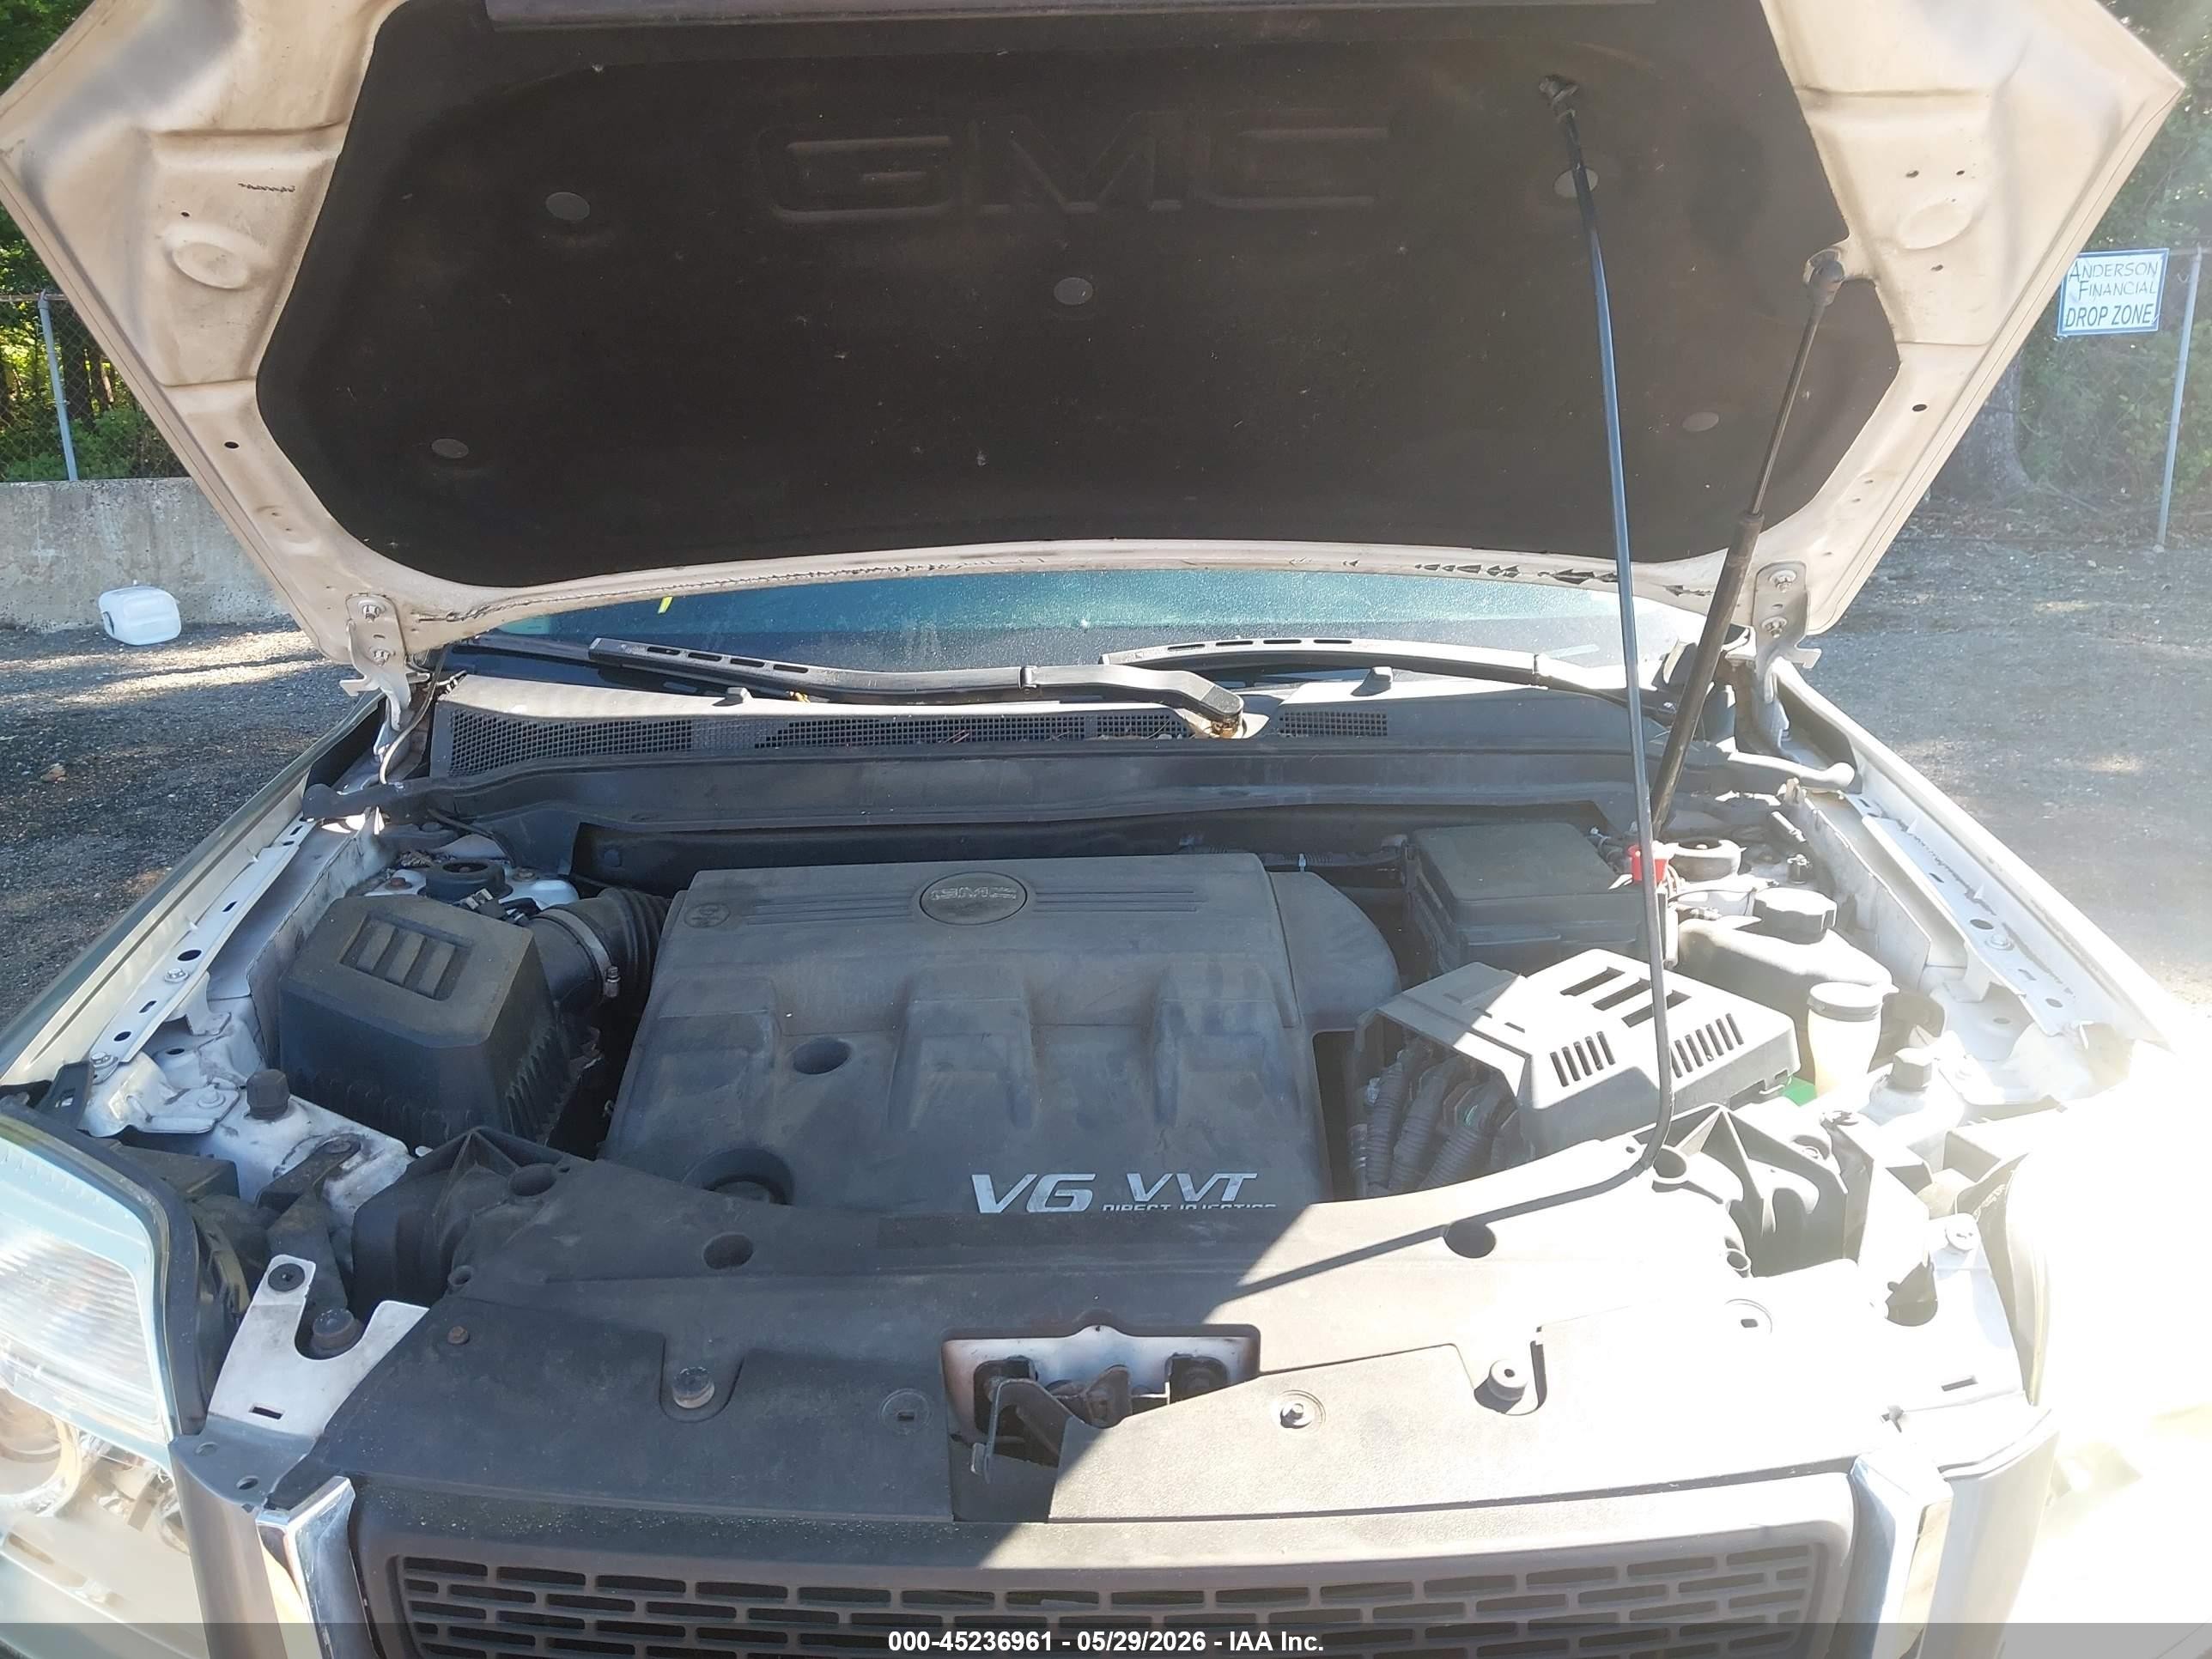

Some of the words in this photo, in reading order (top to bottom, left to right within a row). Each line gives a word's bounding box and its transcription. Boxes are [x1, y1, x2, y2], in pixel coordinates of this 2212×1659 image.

[759, 112, 1391, 222] GMC
[2069, 261, 2158, 282] ANDERSON
[2079, 281, 2156, 300] FINANCIAL
[2065, 307, 2108, 326] DROP
[2112, 304, 2154, 325] ZONE
[971, 1173, 1097, 1214] V6
[1126, 1172, 1257, 1203] VVT
